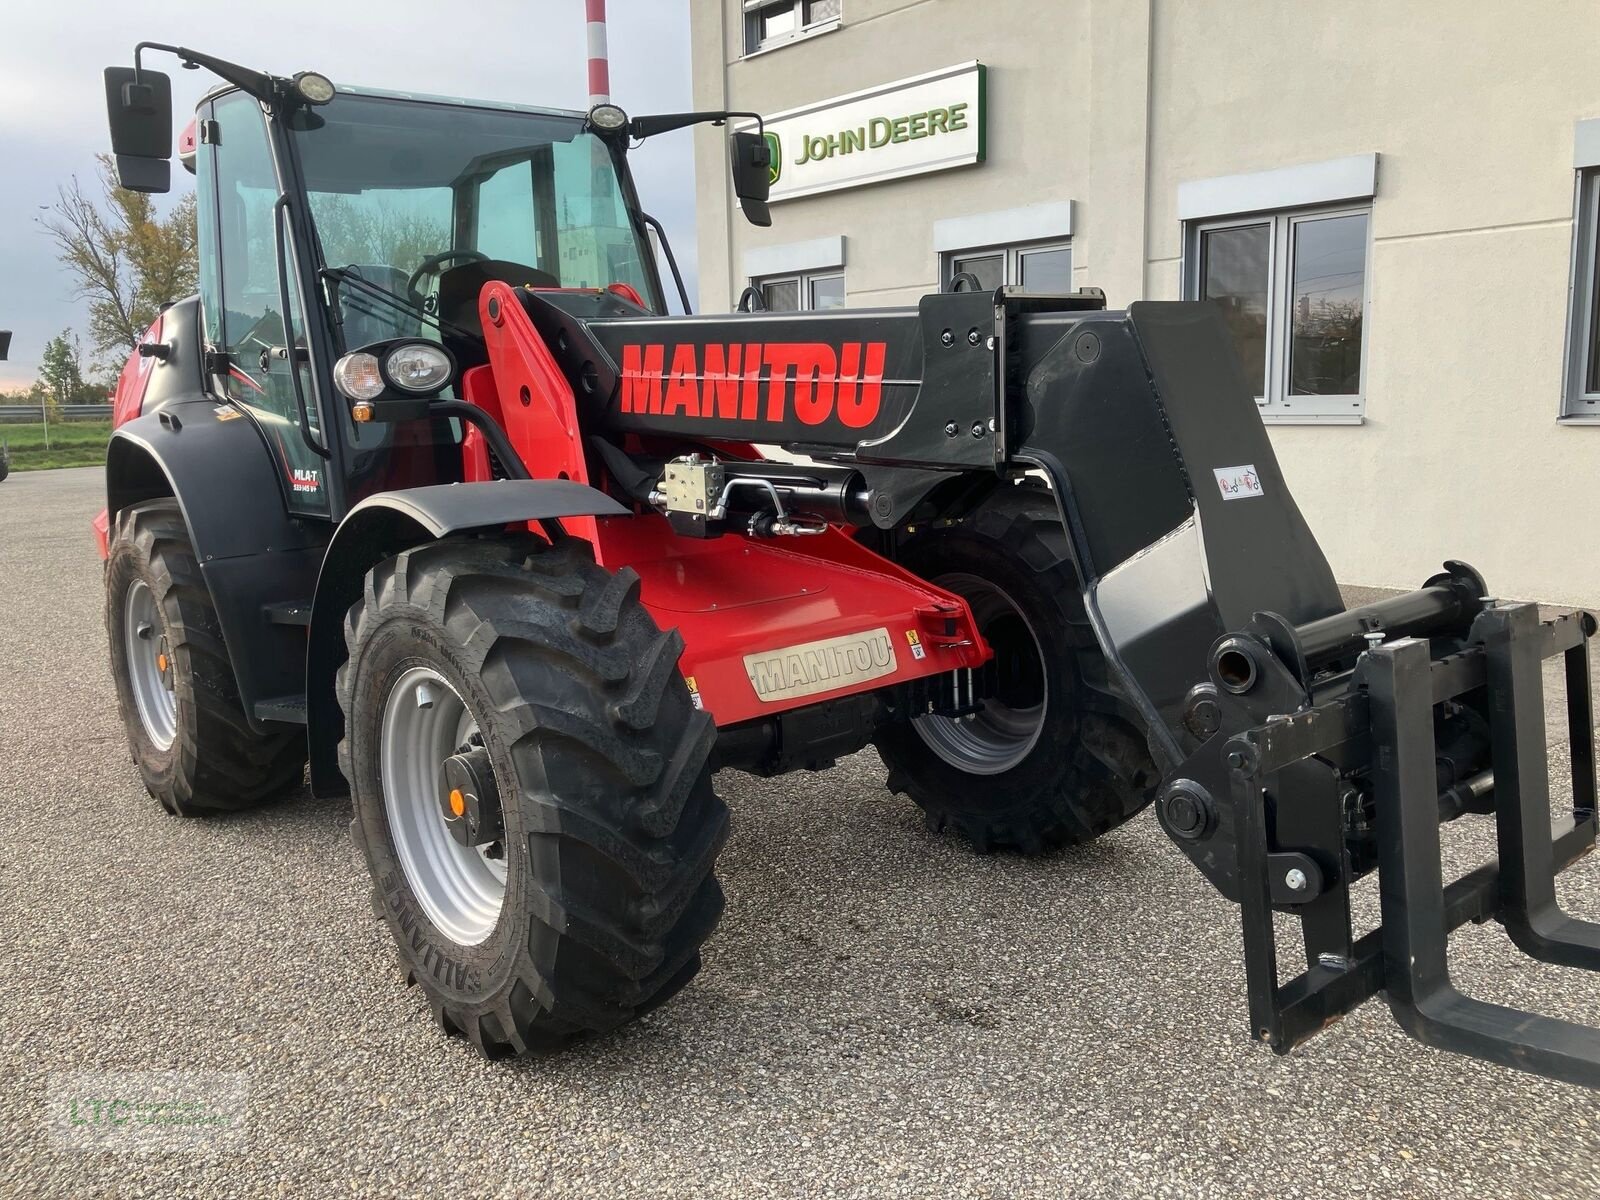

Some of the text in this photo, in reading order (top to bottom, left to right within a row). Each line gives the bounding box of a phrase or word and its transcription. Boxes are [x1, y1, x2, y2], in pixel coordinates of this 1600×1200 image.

[621, 342, 887, 428] MANITOU
[753, 635, 892, 695] MANITOU
[383, 870, 471, 991] ALLIANCE
